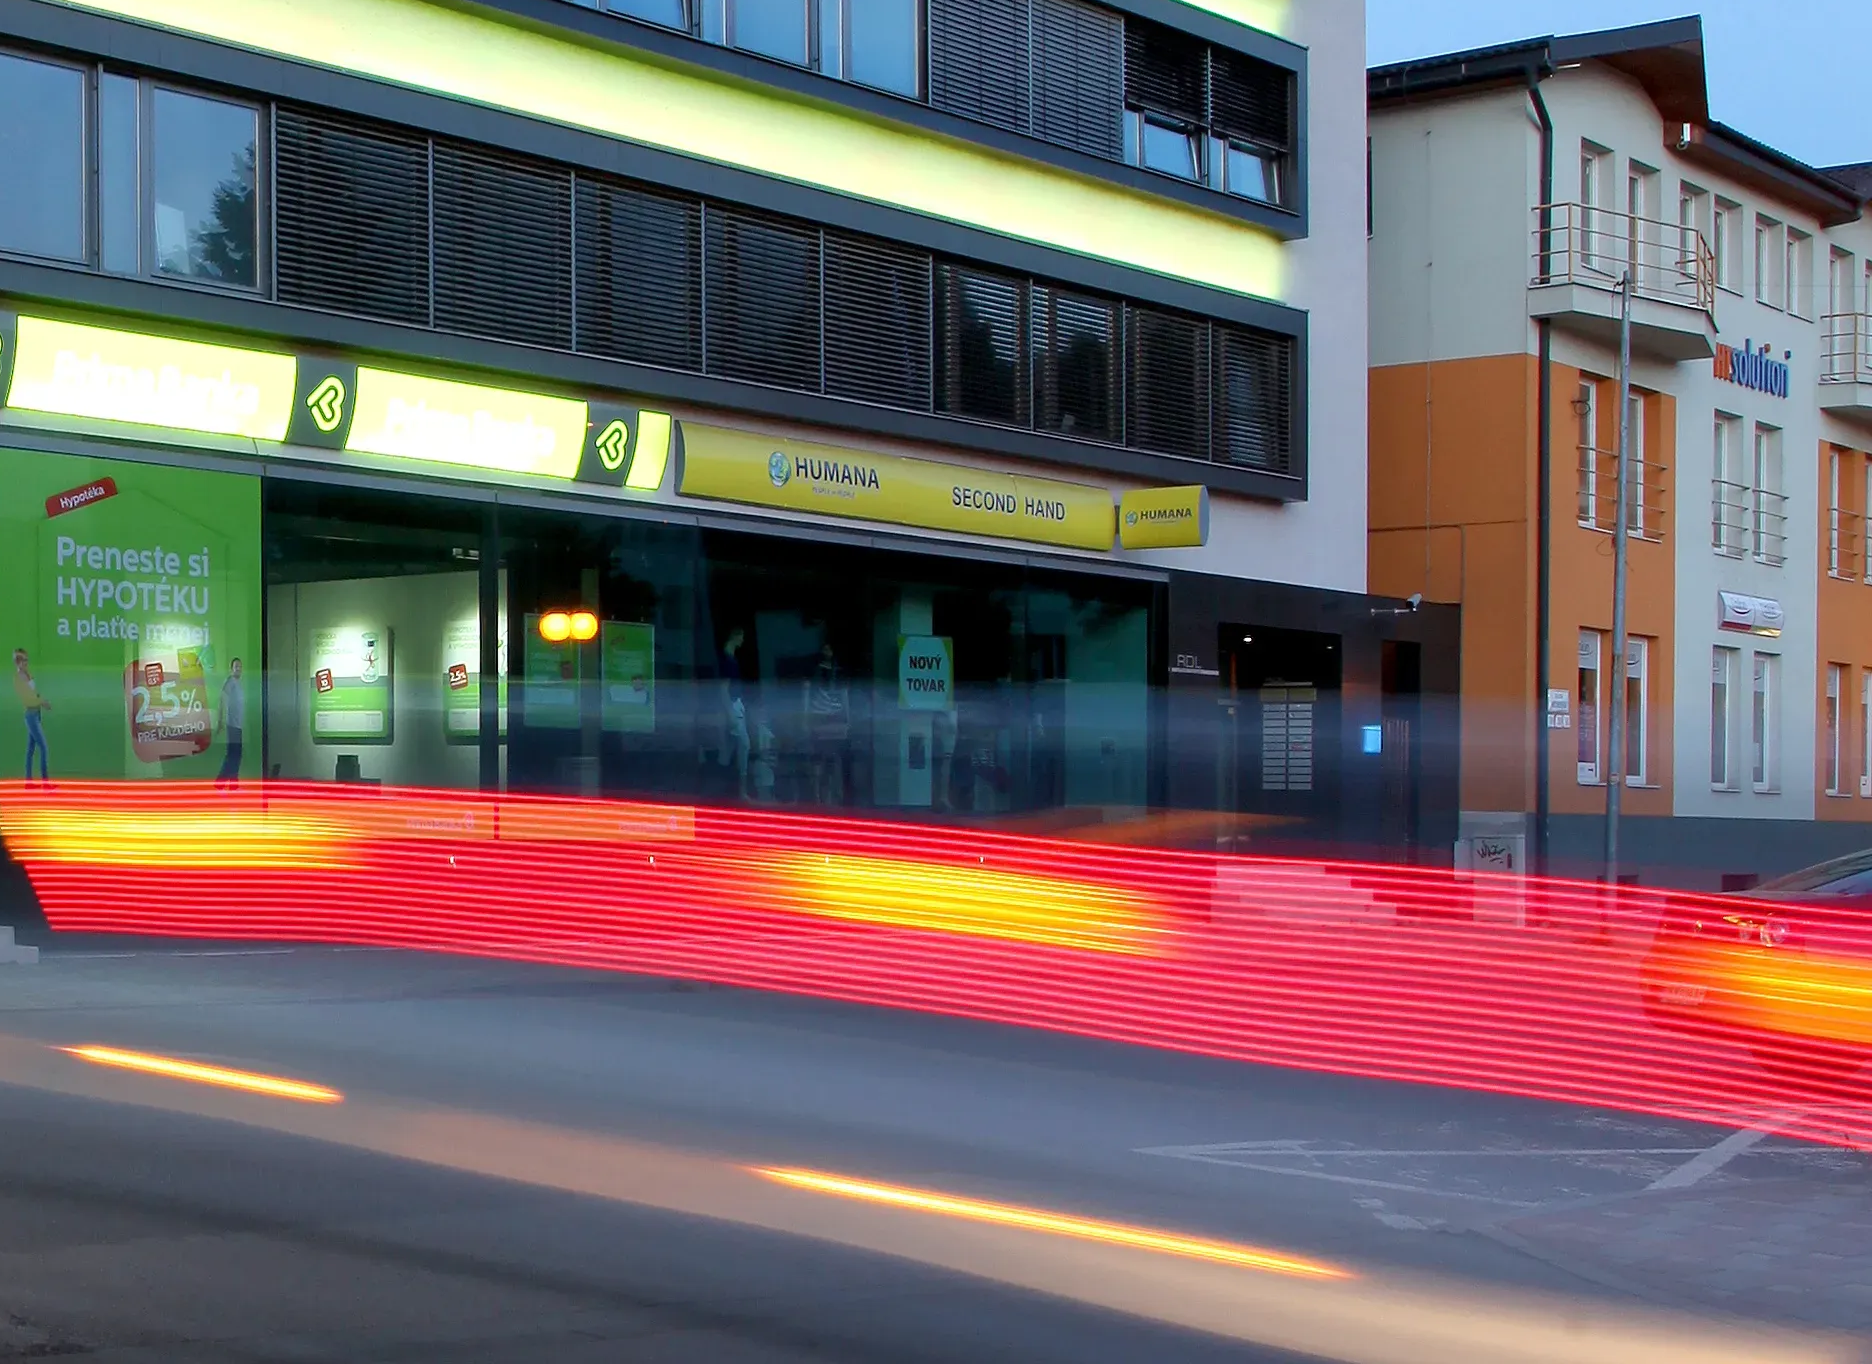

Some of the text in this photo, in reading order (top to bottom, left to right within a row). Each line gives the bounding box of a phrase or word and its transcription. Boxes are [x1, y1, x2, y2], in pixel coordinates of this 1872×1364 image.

[795, 456, 880, 490] HUMANA
[59, 484, 105, 508] Hypotéka
[952, 486, 1065, 520] SECOND HAND
[1140, 508, 1192, 520] HUMANA
[57, 536, 209, 577] Preneste si
[57, 576, 209, 615] HYPOTÉKU
[57, 614, 210, 645] a plaťte menej
[909, 654, 942, 670] NOVÝ
[906, 678, 945, 692] TOVAR
[138, 731, 157, 743] PRE
